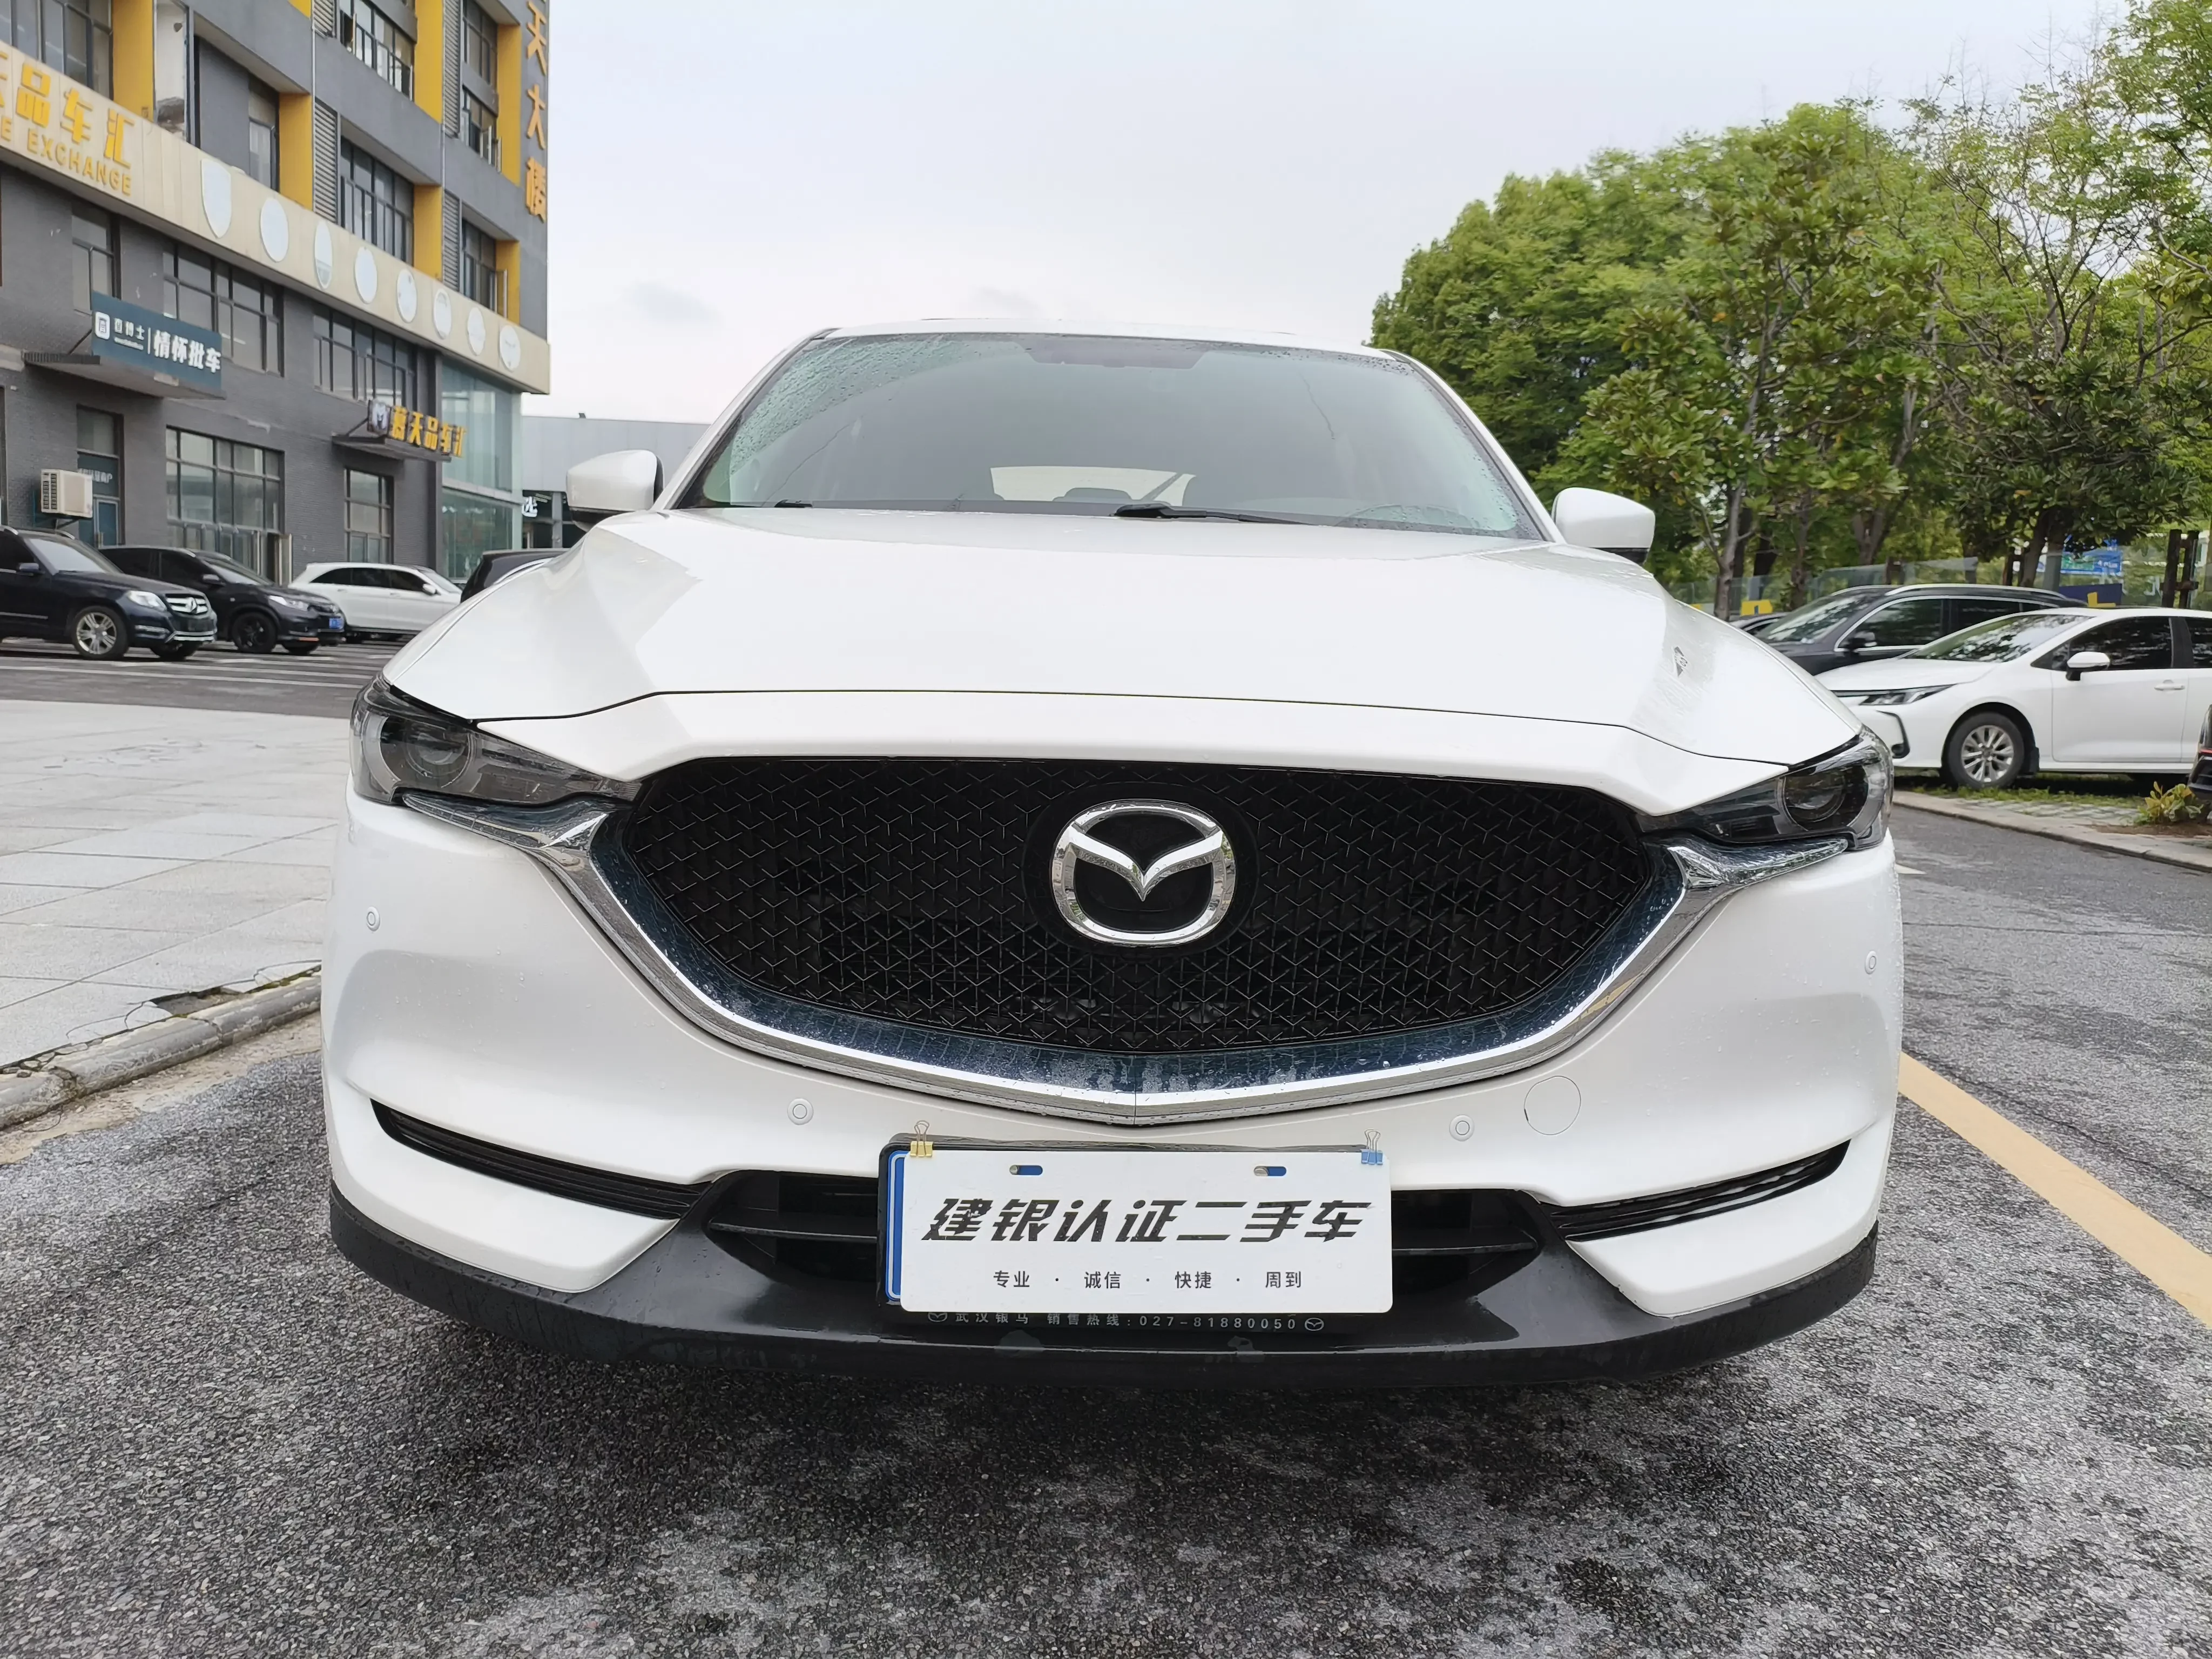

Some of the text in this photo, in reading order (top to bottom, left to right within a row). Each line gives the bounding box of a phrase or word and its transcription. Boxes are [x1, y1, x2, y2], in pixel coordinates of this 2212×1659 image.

[0, 51, 134, 170] 品车汇
[27, 127, 131, 197] EXCHANGE
[153, 329, 221, 373] 情怀批车
[921, 1198, 1372, 1243] 建银认证二手车
[993, 1270, 1301, 1290] 专业 诚信 快捷 周到
[955, 1312, 1028, 1324] 武汉银马
